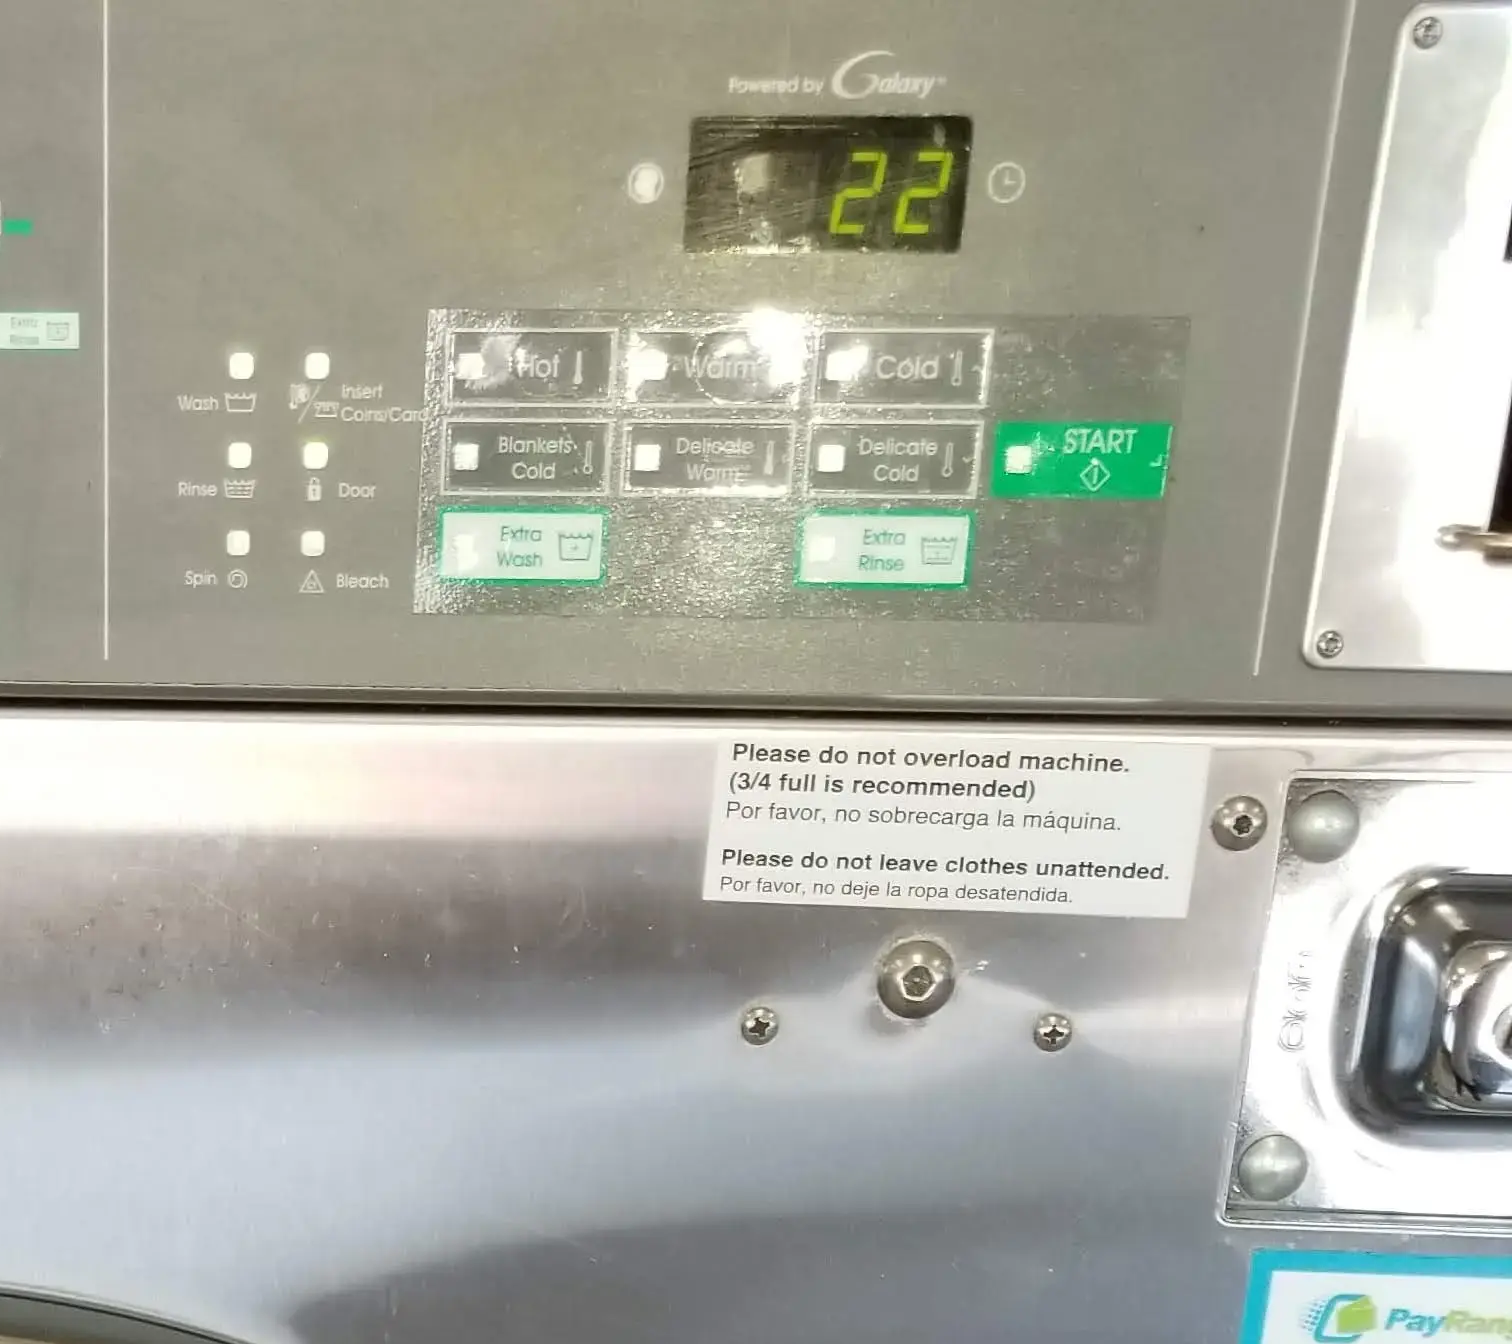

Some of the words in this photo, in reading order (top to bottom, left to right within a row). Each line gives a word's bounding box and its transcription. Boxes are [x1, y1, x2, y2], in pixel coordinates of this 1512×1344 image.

[729, 76, 799, 94] Powered
[803, 77, 824, 96] by
[830, 151, 954, 235] 22
[876, 355, 939, 380] Cold
[341, 383, 383, 399] Insert
[178, 396, 219, 411] Wash
[499, 435, 572, 455] Blankets
[858, 438, 937, 456] Delicate
[1063, 428, 1137, 455] START
[512, 463, 555, 480] Cold
[874, 464, 919, 483] Cold
[178, 482, 217, 498] Rinse
[339, 483, 376, 498] Door
[500, 526, 542, 542] Extra
[863, 528, 906, 546] Extra
[497, 550, 542, 567] Wash
[859, 554, 904, 572] Rinse
[185, 571, 217, 588] Spin
[337, 573, 389, 589] Bleach
[734, 744, 810, 763] Please
[819, 746, 848, 764] do
[858, 749, 896, 765] not
[904, 750, 1010, 768] overload
[1019, 753, 1128, 772] machine.
[730, 772, 771, 794] (3/4
[779, 774, 816, 792] full
[825, 775, 843, 792] is
[853, 780, 1035, 803] recommended)
[727, 801, 762, 819] Por
[769, 803, 825, 824] favor,
[835, 809, 861, 822] no
[868, 806, 988, 830] sobrecarga
[997, 810, 1014, 827] la
[1023, 811, 1120, 833] máquina.
[723, 849, 793, 867] Please
[801, 852, 828, 868] do
[837, 855, 872, 869] not
[880, 854, 938, 872] leave
[946, 857, 1027, 875] clothes
[1037, 862, 1168, 879] unattended.
[721, 876, 751, 891] Por
[757, 878, 805, 895] favor,
[813, 883, 835, 894] no
[842, 881, 879, 899] deje
[887, 882, 901, 896] la
[908, 886, 948, 901] ropa
[955, 885, 1072, 902] desatendida.
